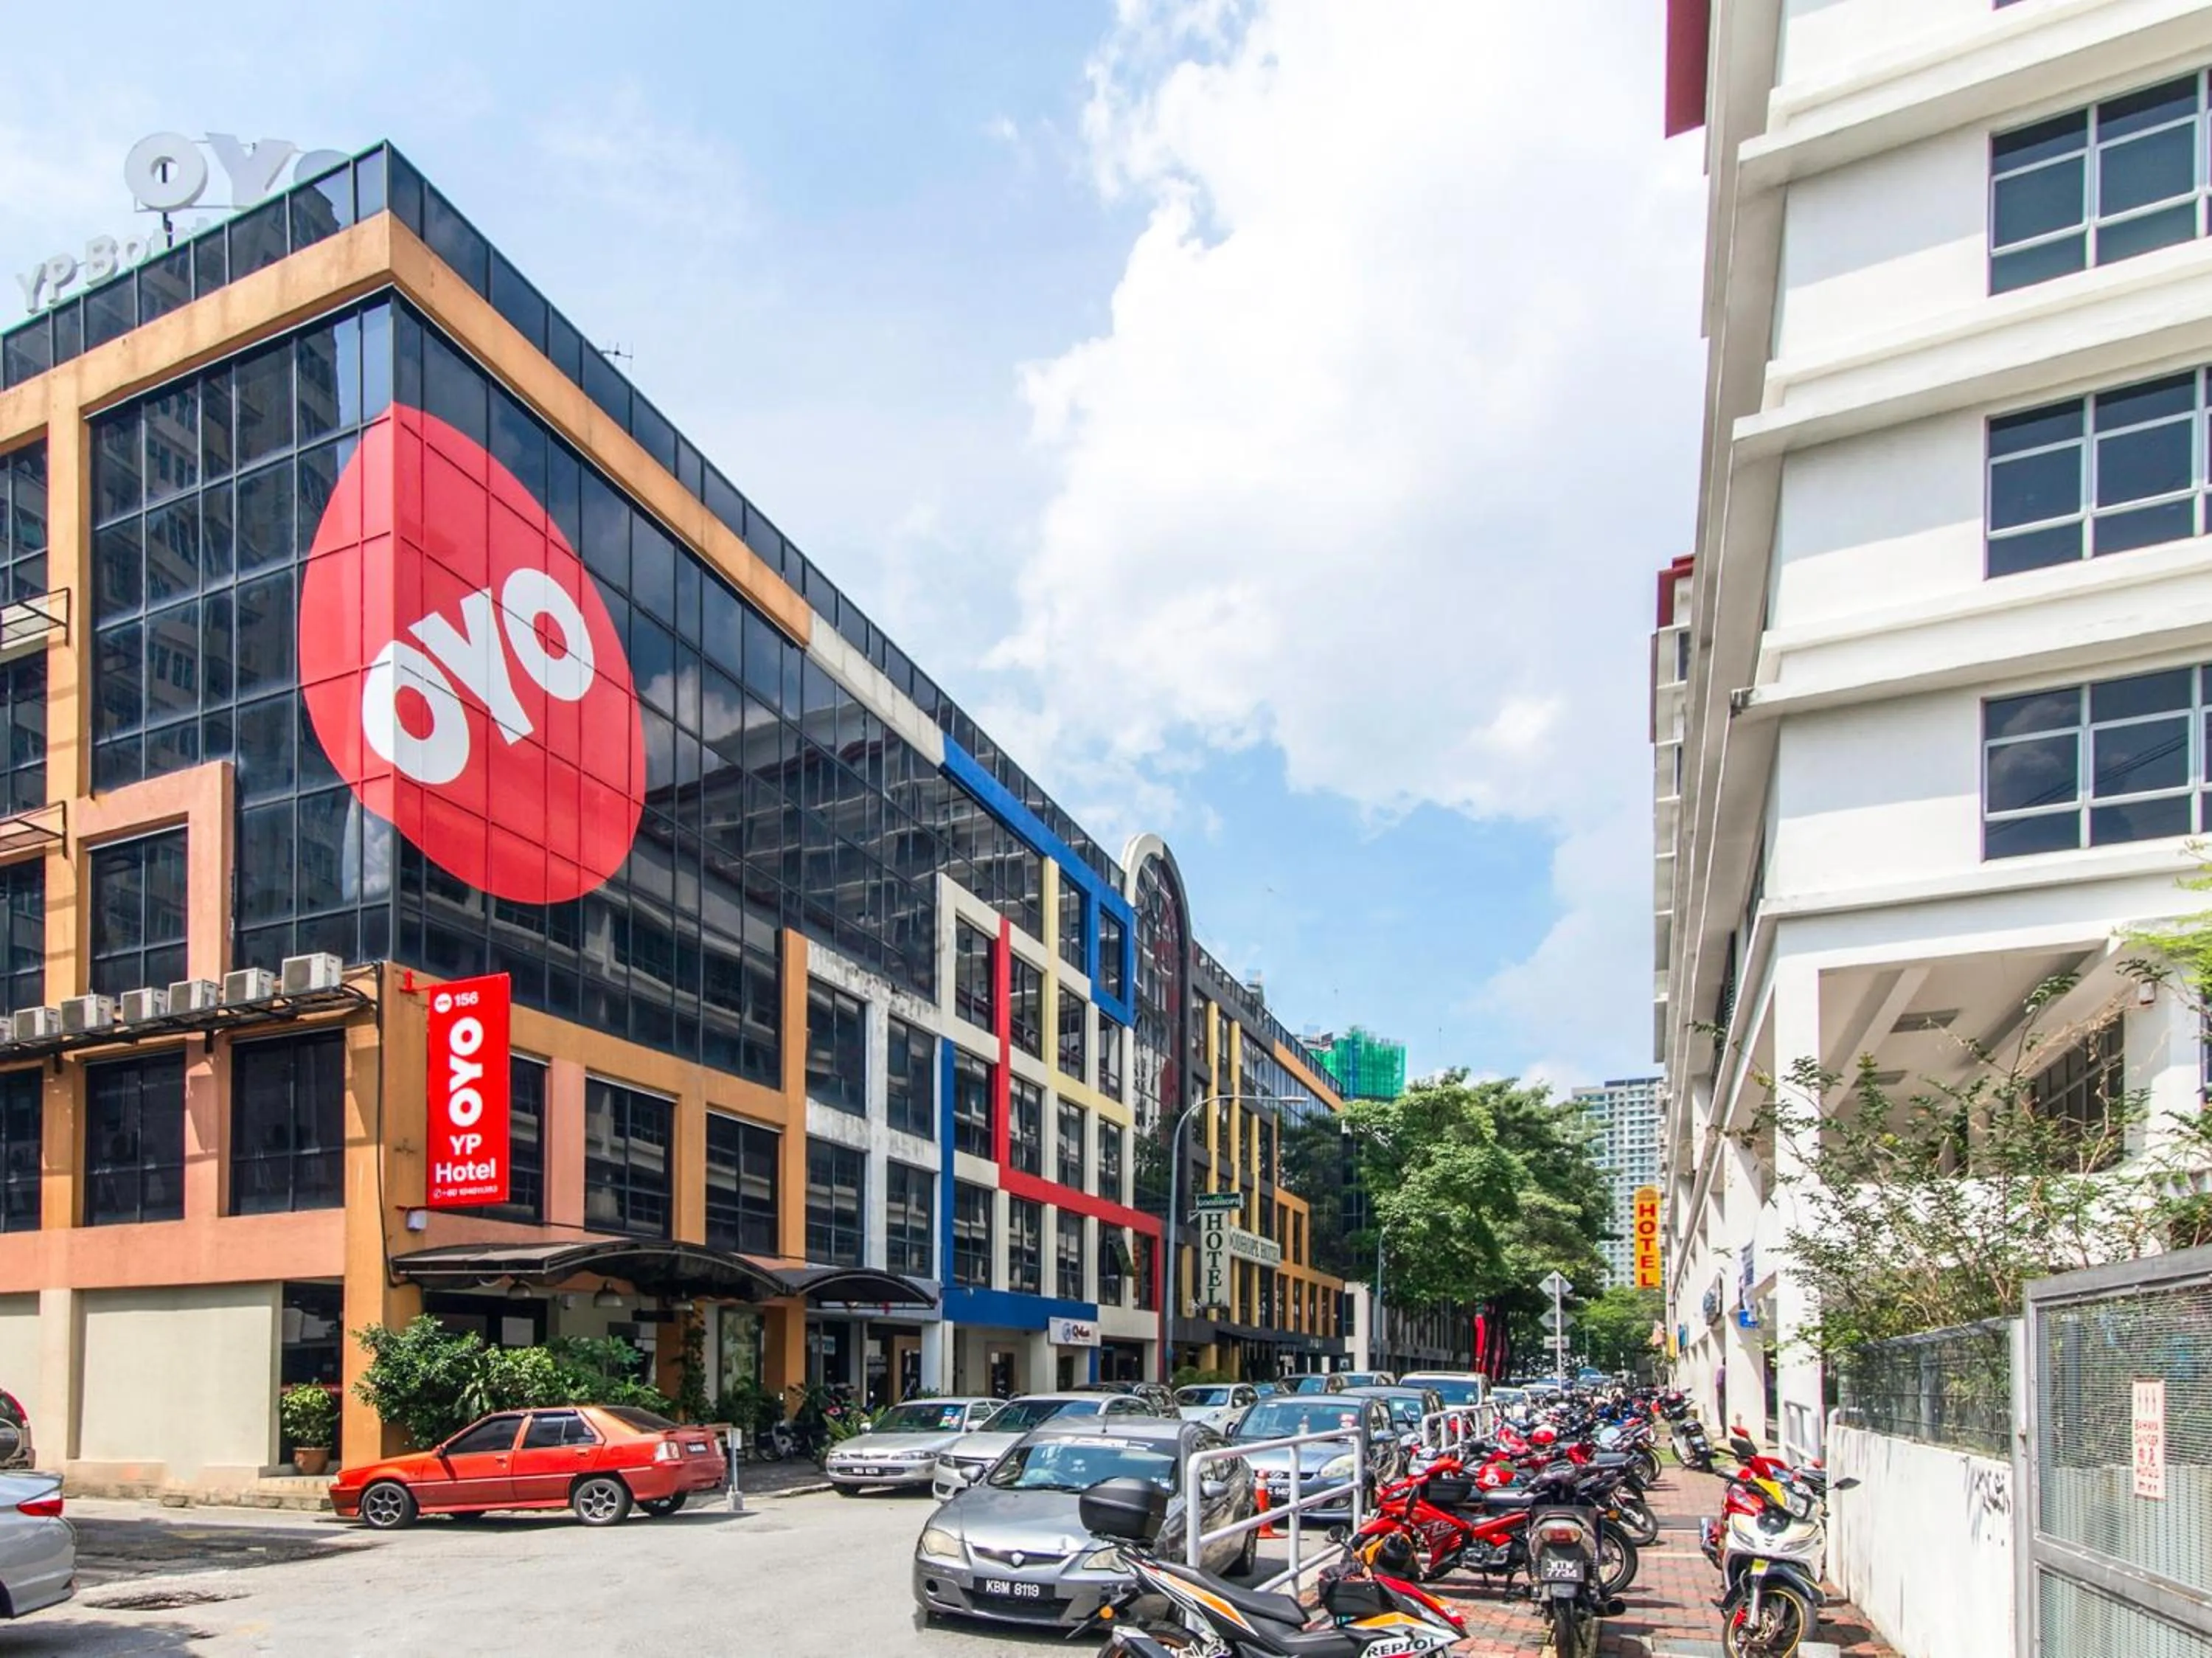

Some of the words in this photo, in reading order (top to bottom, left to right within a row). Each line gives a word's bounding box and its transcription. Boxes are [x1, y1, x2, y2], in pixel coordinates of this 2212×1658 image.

[15, 253, 77, 315] YP
[362, 567, 594, 784] OYO
[455, 991, 479, 1007] 156
[449, 1017, 484, 1127] OYO
[450, 1134, 481, 1156] YP
[436, 1158, 496, 1184] Hotel
[1205, 1213, 1223, 1305] HOTEL
[1638, 1203, 1656, 1286] HOTEL
[986, 1579, 1009, 1593] KBM
[1014, 1582, 1039, 1597] 8119
[1367, 1631, 1438, 1657] REPSOL
